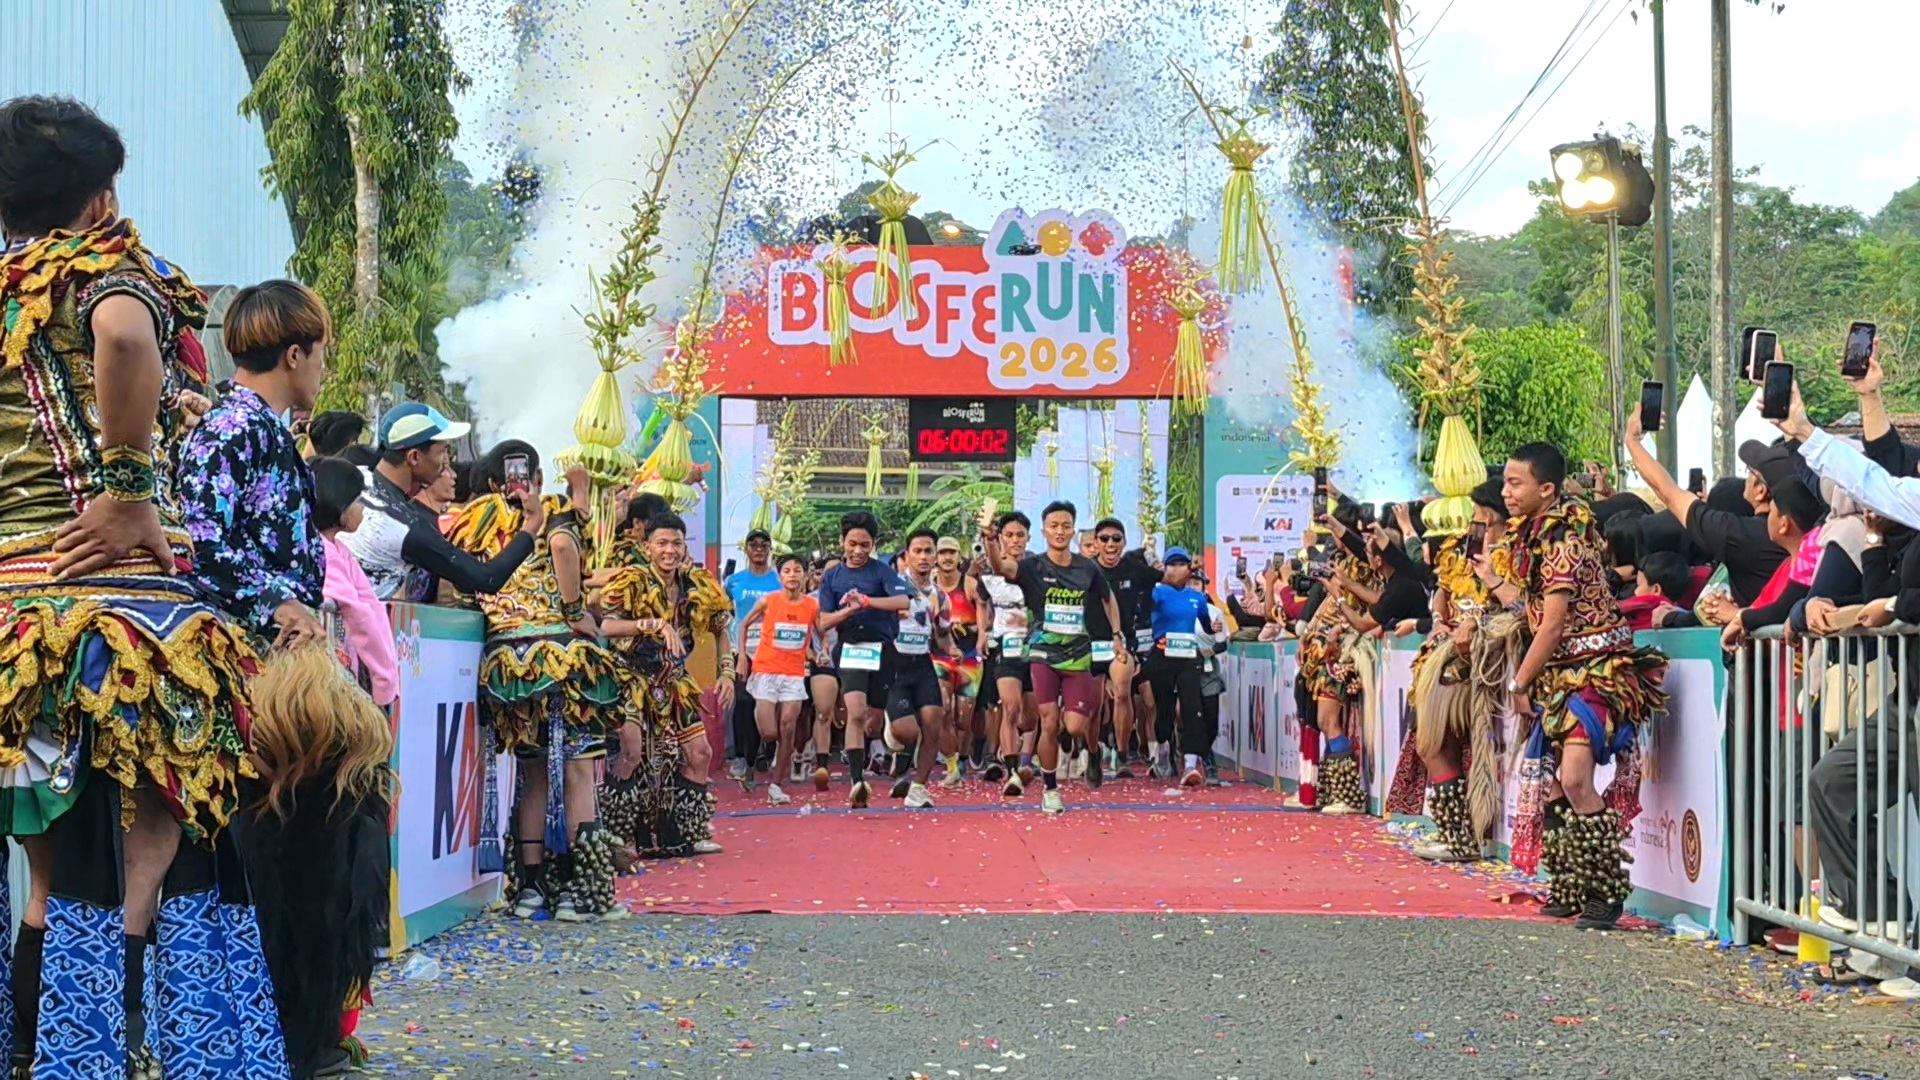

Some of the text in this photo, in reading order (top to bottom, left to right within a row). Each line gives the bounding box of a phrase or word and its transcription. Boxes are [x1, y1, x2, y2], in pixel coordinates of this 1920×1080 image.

[1000, 337, 1118, 377] 2026
[919, 429, 1008, 453] 06:00:02
[1264, 518, 1293, 530] KAI
[432, 702, 482, 860] KA
